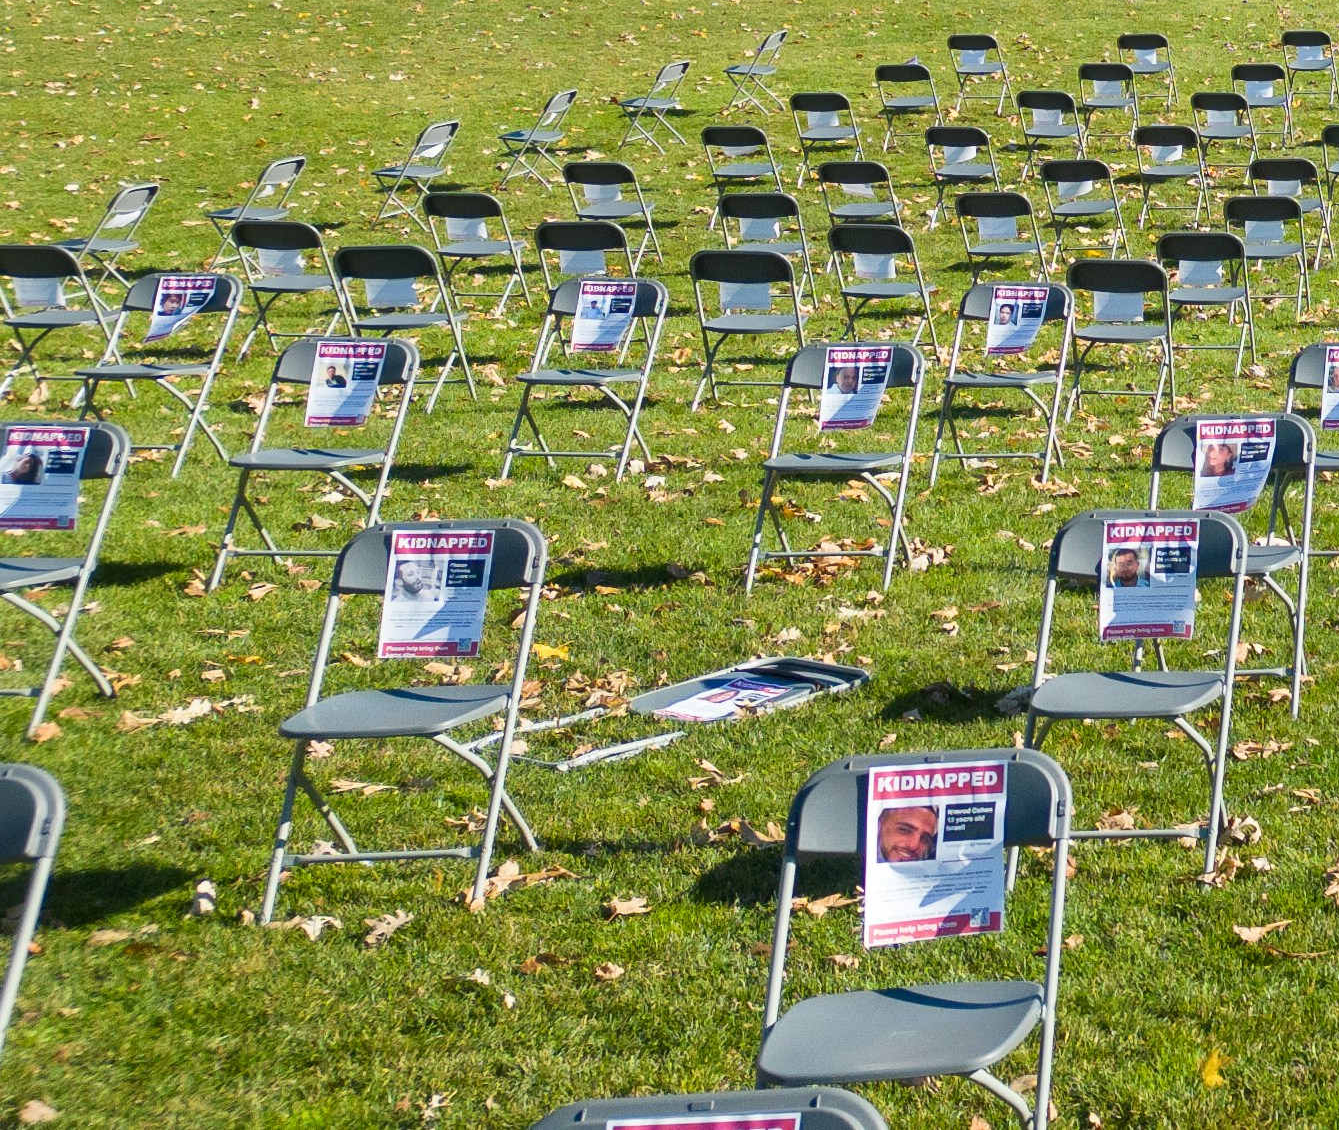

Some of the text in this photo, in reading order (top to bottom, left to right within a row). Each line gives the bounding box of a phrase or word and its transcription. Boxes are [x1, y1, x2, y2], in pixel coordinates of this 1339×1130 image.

[584, 284, 634, 293] KIDNAPPED
[997, 289, 1045, 297] KIDNAPPED
[320, 345, 382, 356] KIDNAPPED
[830, 350, 888, 360] KIDNAPPED
[1201, 423, 1272, 435] KIDNAPPED
[10, 431, 81, 442] KIDNAPPED
[1110, 525, 1193, 538] KIDNAPPED
[398, 537, 488, 549] KIDNAPPED
[877, 770, 998, 792] KIDNAPPED
